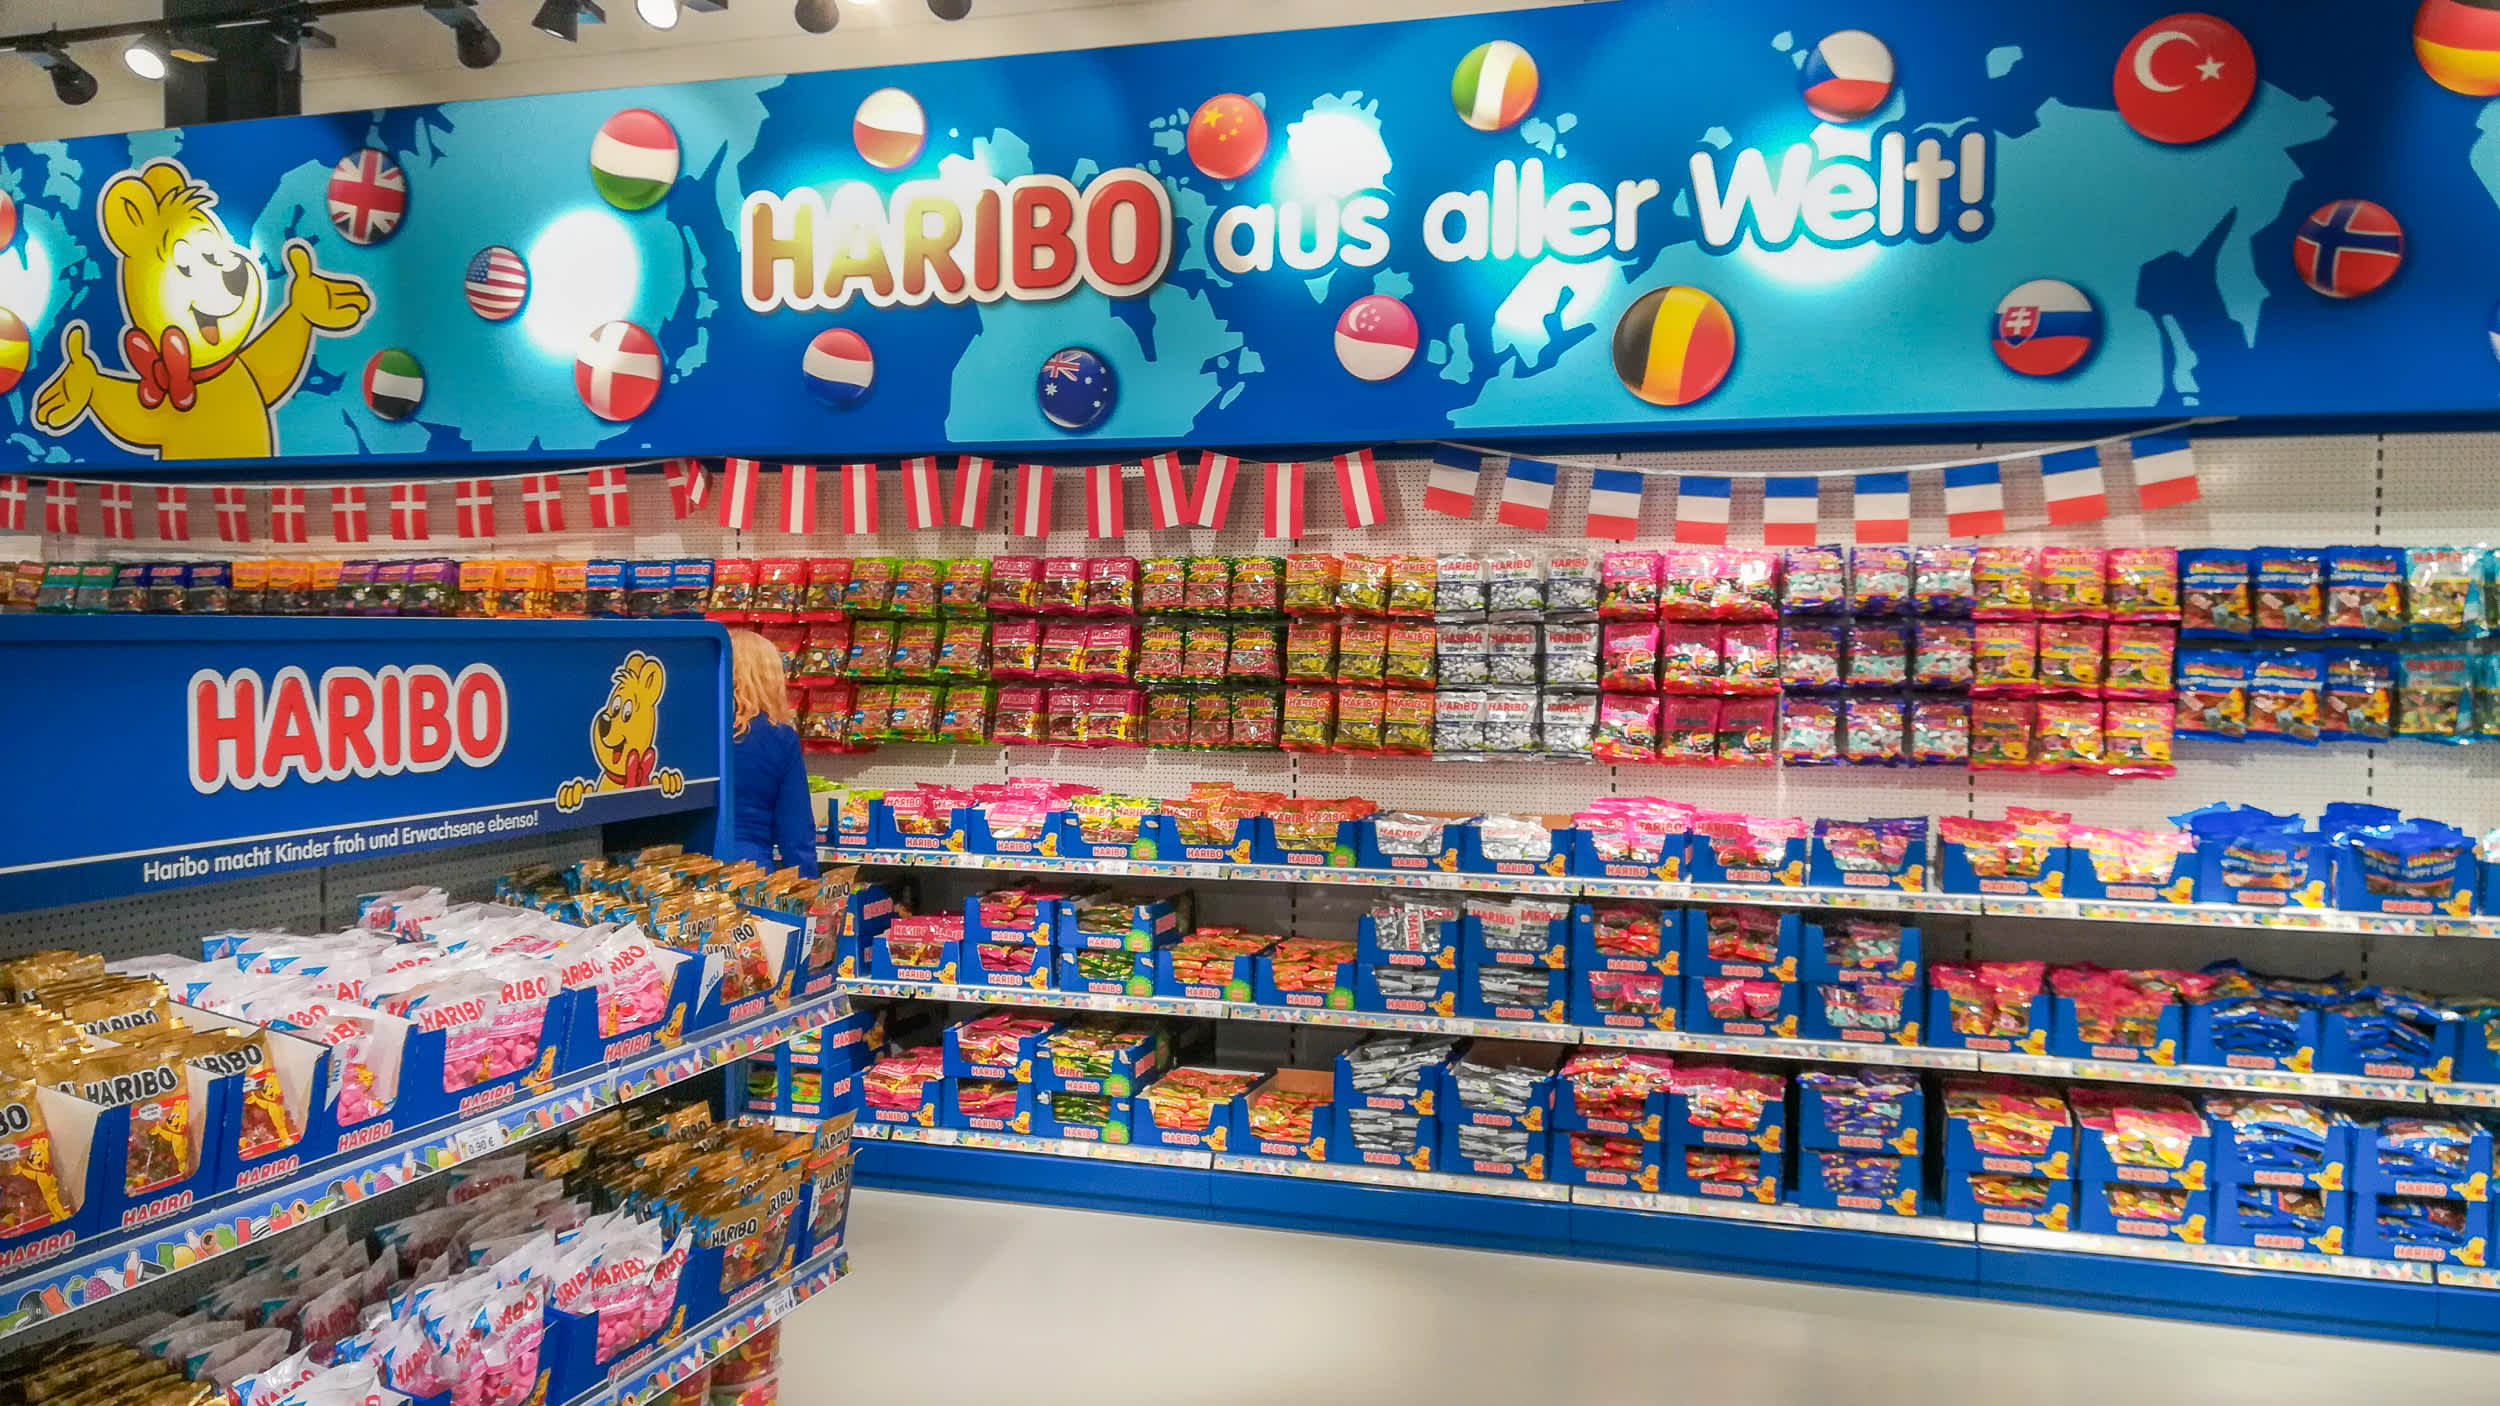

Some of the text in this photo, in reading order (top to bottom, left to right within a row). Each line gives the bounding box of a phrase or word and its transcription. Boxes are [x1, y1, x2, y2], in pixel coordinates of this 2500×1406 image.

[748, 131, 1986, 305] HARIBO aus aller Welt!
[1144, 562, 1182, 572] HARIBO
[1191, 562, 1226, 572] HARIBO
[1235, 562, 1272, 572] HARIBO
[1439, 561, 1480, 571] HARIBO
[1490, 560, 1532, 570] HARIBO
[1551, 558, 1589, 568] HARIBO
[1143, 631, 1180, 640] HARIBO
[1190, 631, 1226, 641] HARIBO
[1235, 631, 1272, 640] HARIBO
[1391, 632, 1433, 641] HARIBO
[1491, 633, 1532, 644] HARIBO
[1549, 632, 1593, 642] HARIBO
[1342, 699, 1380, 708] HARIBO
[1437, 702, 1478, 711] HARIBO
[1488, 703, 1529, 712] HARIBO
[193, 669, 505, 787] HARIBO
[886, 797, 921, 807] HARIBO
[1074, 804, 1112, 817] HARIBO
[143, 809, 539, 883] Haribo macht Kinder froh und Erwachsene ebenso!
[839, 836, 867, 845] HARIBO
[905, 837, 940, 849] HARIBO
[996, 841, 1032, 852] HARIBO
[1092, 846, 1127, 858] HARIBO
[1186, 848, 1224, 860] HARIBO
[1287, 854, 1324, 865] HARIBO
[1391, 857, 1429, 868] HARIBO
[1497, 862, 1535, 875] HARIBO
[1606, 864, 1649, 877] HARIBO
[1727, 870, 1771, 880] HARIBO
[1472, 909, 1515, 925] HARIBO
[992, 931, 1024, 942] HARIBO
[1088, 937, 1121, 949] HARIBO
[1389, 954, 1426, 965] HARIBO
[1496, 953, 1534, 964] HARIBO
[1607, 959, 1648, 971] HARIBO
[705, 970, 720, 990] NEU
[897, 970, 932, 980] HARIBO
[988, 974, 1023, 985] HARIBO
[498, 977, 548, 1005] RIBO
[1089, 983, 1123, 994] HARIBO
[1186, 988, 1220, 998] HARIBO
[1286, 994, 1323, 1006] HARIBO
[1386, 999, 1426, 1010] HARIBO
[419, 999, 485, 1032] HARIBO
[729, 998, 765, 1024] HARIBO
[1496, 1008, 1534, 1019] HARIBO
[1604, 1015, 1644, 1026] HARIBO
[604, 1032, 651, 1062] HARIBO
[971, 1066, 1006, 1078] HARIBO
[85, 1065, 178, 1107] HARIBO
[1065, 1080, 1100, 1092] HARIBO
[459, 1082, 515, 1119] HARIBO
[1366, 1097, 1405, 1109] HARIBO
[876, 1109, 909, 1122] HARIBO
[1473, 1113, 1512, 1126] HARIBO
[970, 1117, 1004, 1130] HARIBO
[1587, 1119, 1629, 1133] HARIBO
[339, 1120, 393, 1152] HARIBO
[1063, 1127, 1099, 1140] HARIBO
[1162, 1132, 1200, 1145] HARIBO
[1260, 1143, 1298, 1156] HARIBO
[1364, 1152, 1401, 1164] HARIBO
[237, 1155, 299, 1192] HARIBO
[1474, 1161, 1513, 1174] HARIBO
[1586, 1171, 1627, 1185] HARIBO
[123, 1191, 192, 1231] HARIBO
[711, 1218, 758, 1248] HARIBO
[0, 1231, 75, 1275] HARIBO
